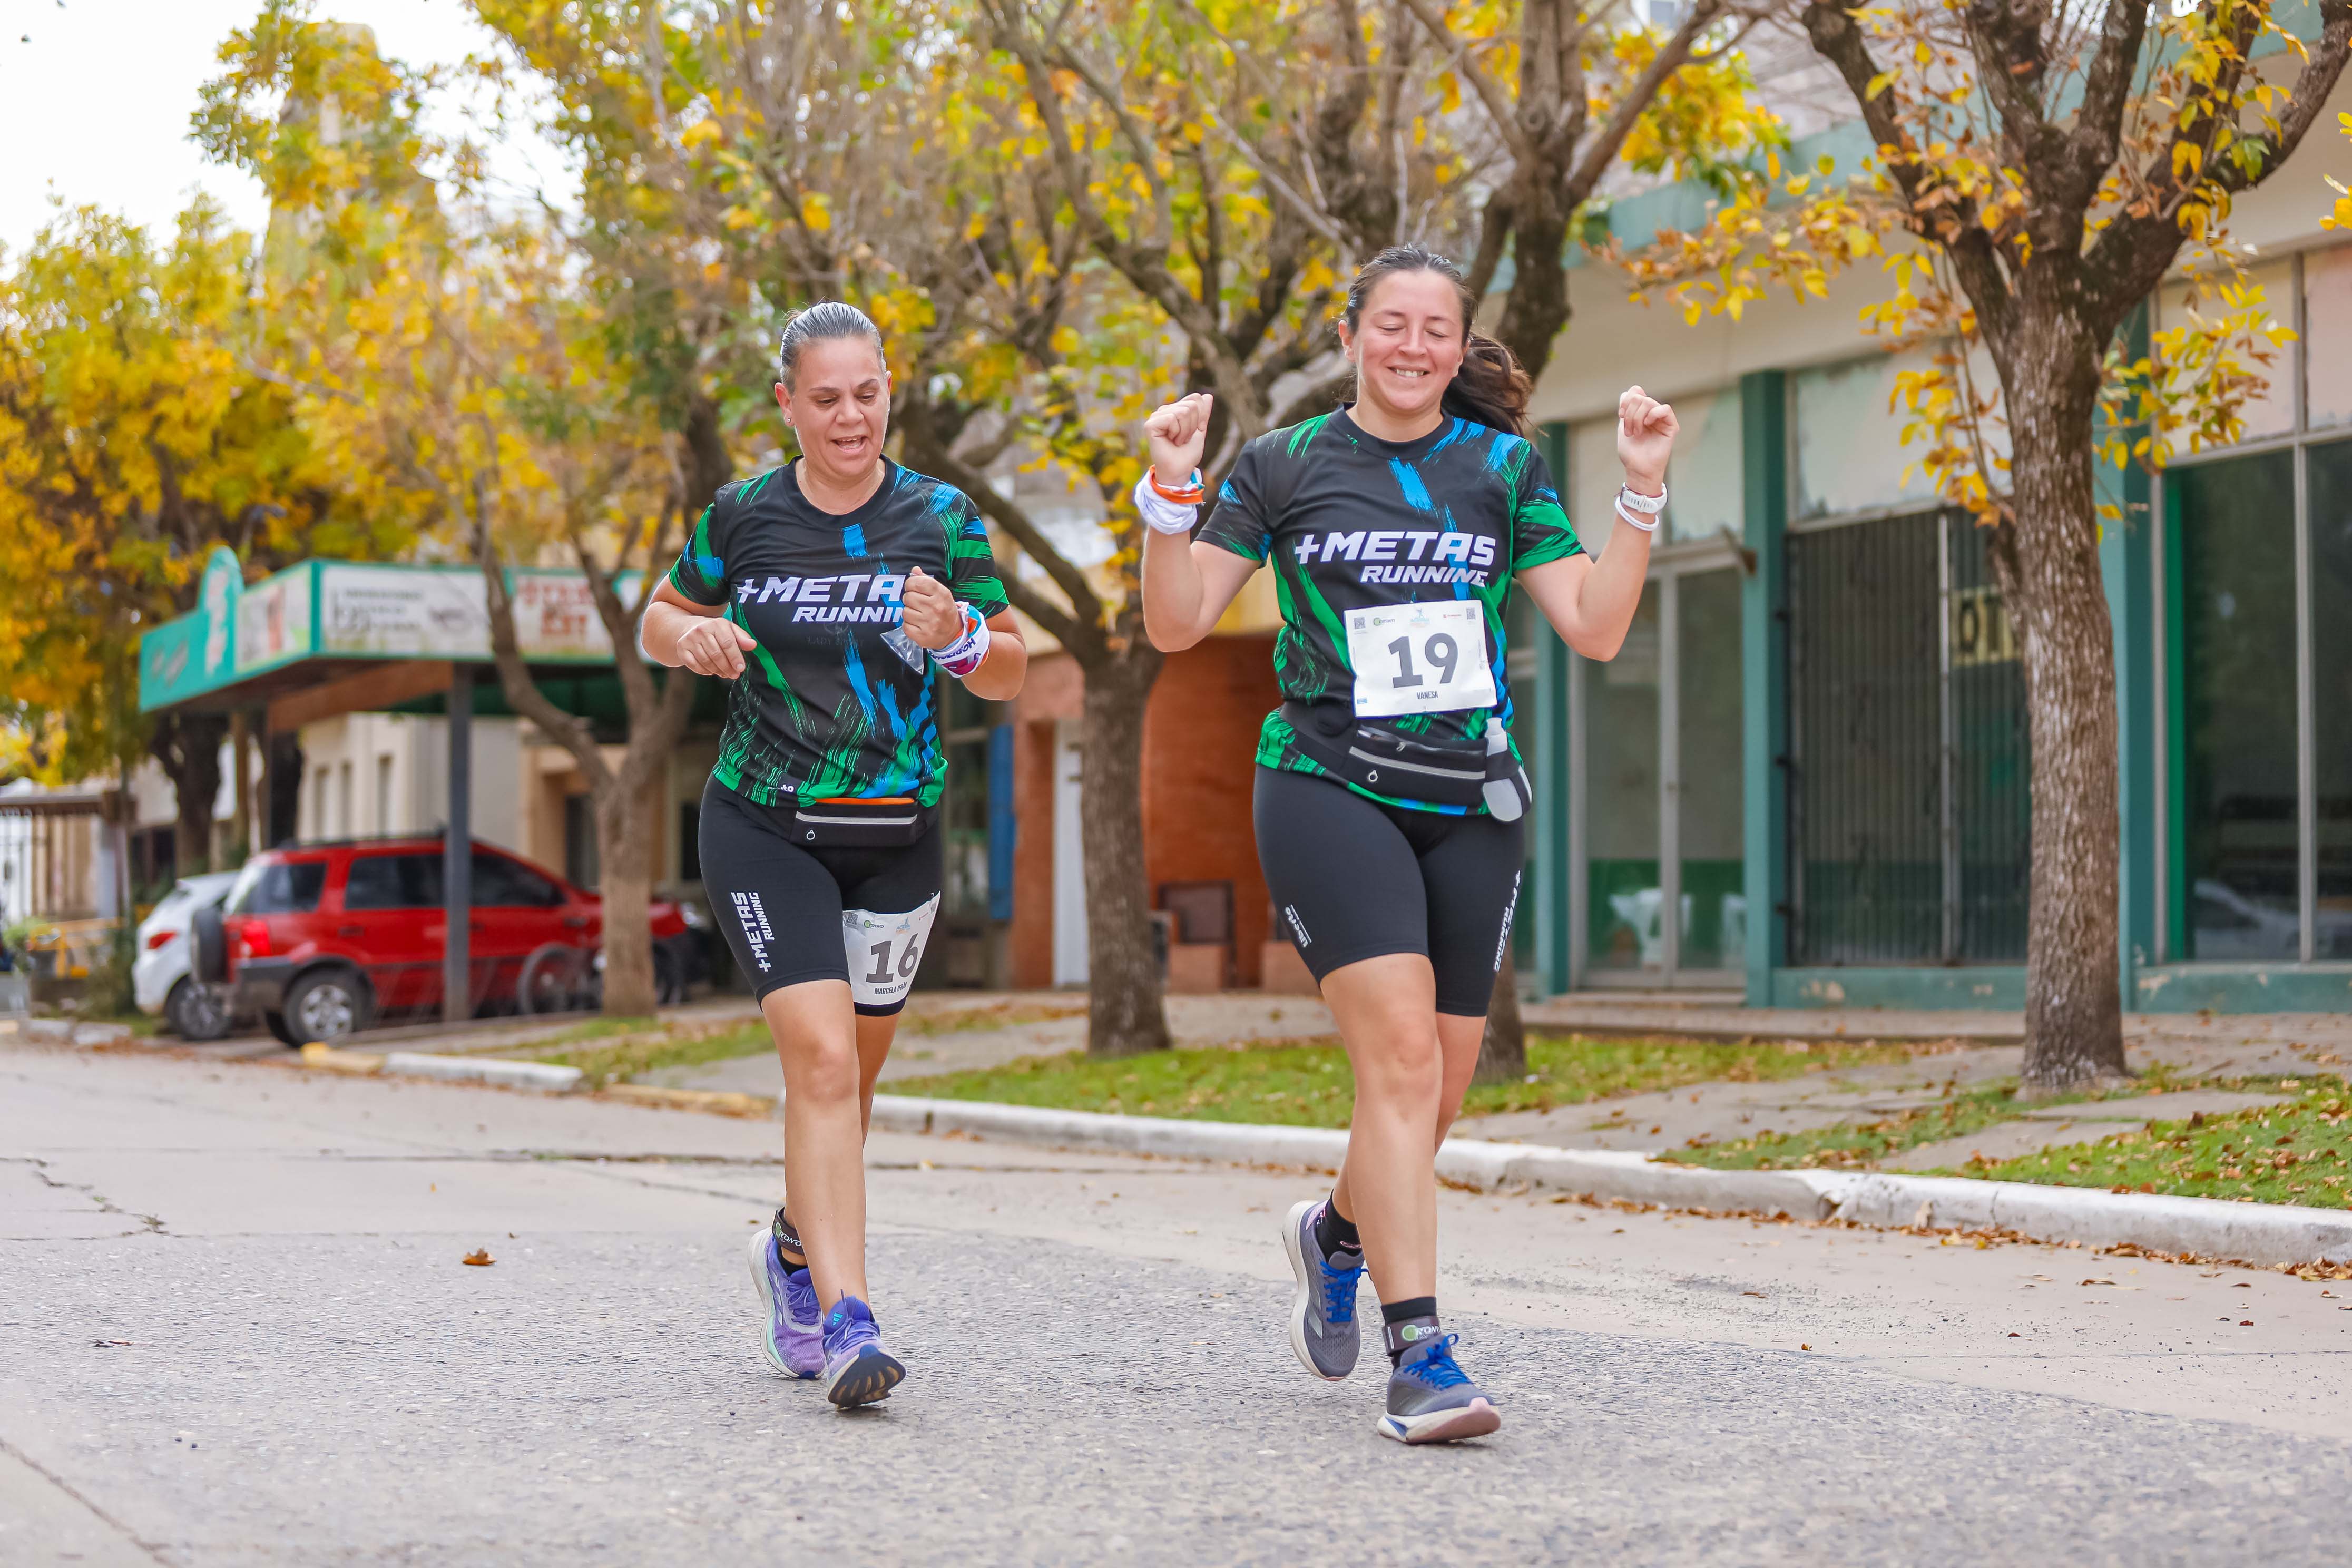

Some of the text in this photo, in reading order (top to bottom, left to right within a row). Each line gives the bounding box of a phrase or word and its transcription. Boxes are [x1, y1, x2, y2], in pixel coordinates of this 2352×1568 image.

[1295, 531, 1496, 566] +METAS
[737, 574, 934, 603] +META
[792, 606, 904, 623] RUNNI
[1388, 632, 1458, 688] 19
[1416, 691, 1438, 700] VANESA
[730, 891, 772, 972] +METAS
[748, 891, 775, 941] RUNNING
[866, 933, 918, 984] 16
[874, 986, 897, 995] MARCELA
